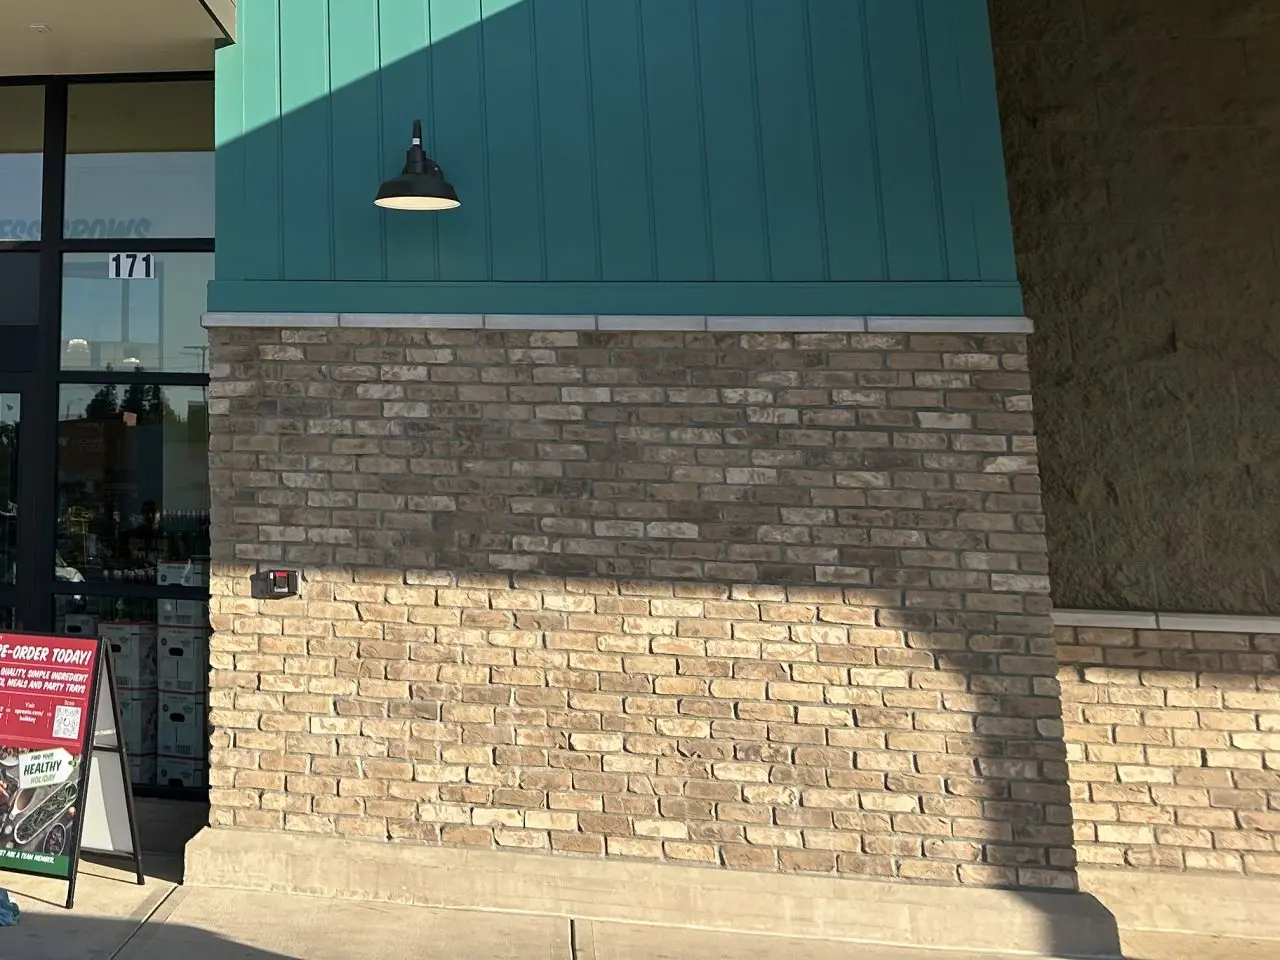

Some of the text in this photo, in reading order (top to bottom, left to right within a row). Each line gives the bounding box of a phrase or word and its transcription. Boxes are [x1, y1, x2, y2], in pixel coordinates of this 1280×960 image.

[63, 217, 152, 239] ROWS
[111, 254, 152, 277] 171
[52, 648, 92, 665] TODAY!
[27, 669, 51, 679] SIMPLE
[51, 671, 88, 683] INGREDIENT
[7, 678, 29, 688] MEALS
[29, 680, 43, 689] AND
[43, 681, 64, 691] PARTY
[66, 683, 87, 694] TRAYS
[23, 760, 62, 776] HEALTHY
[30, 774, 56, 784] HOLIDAY
